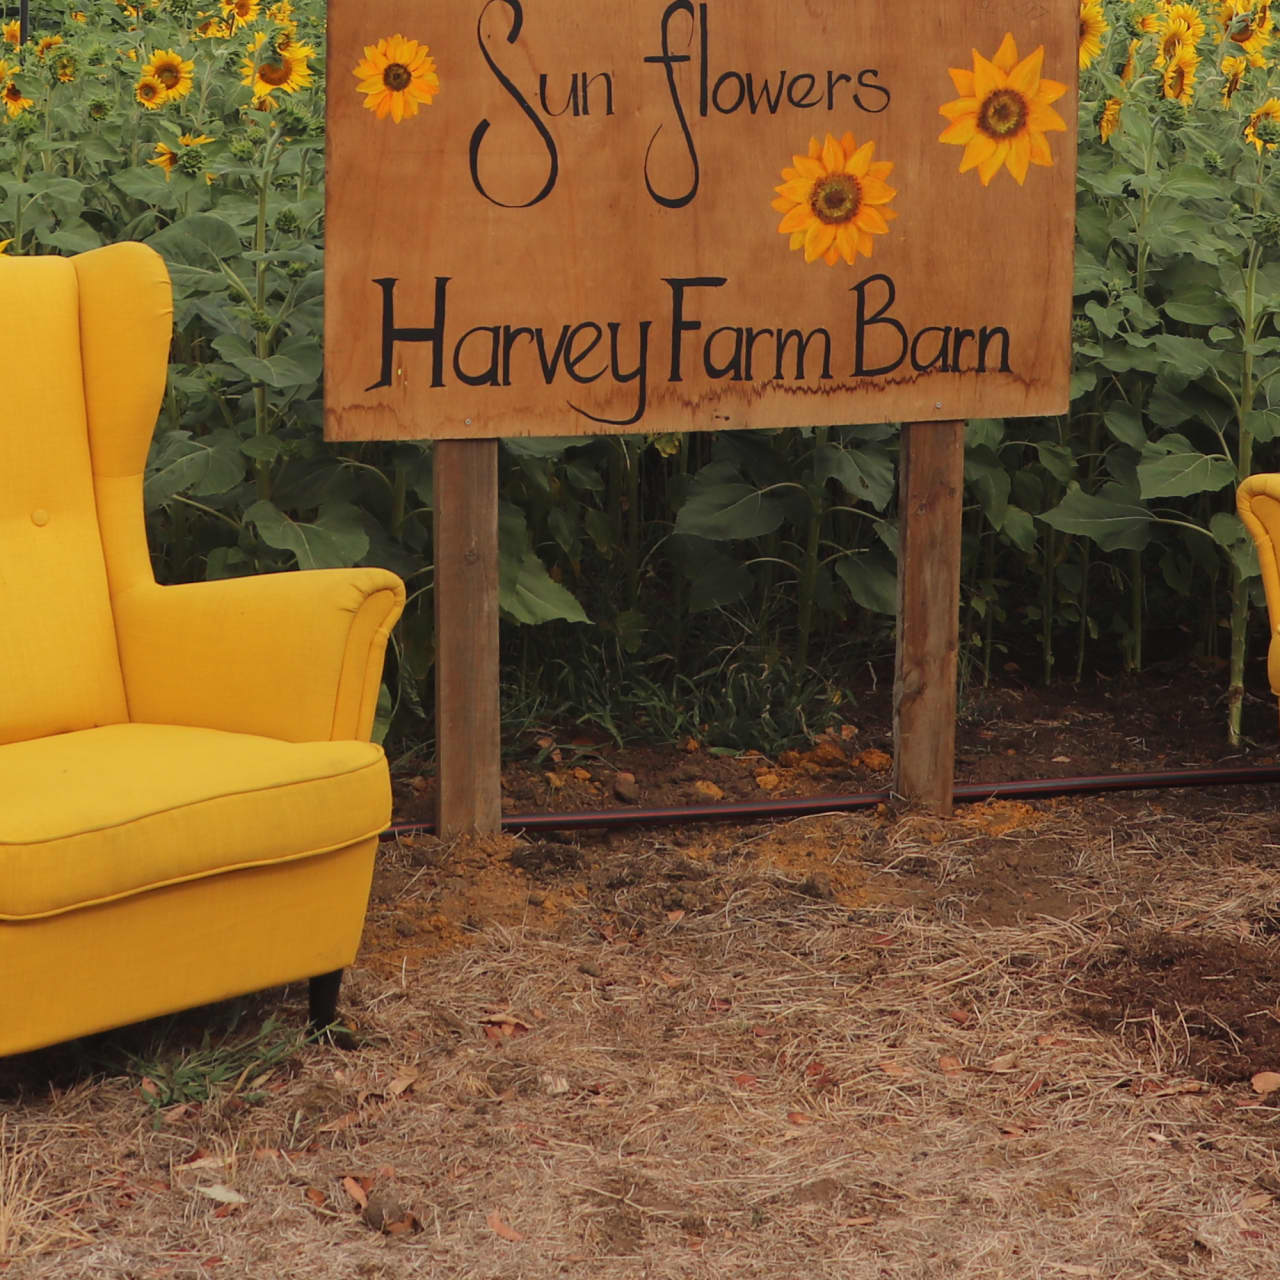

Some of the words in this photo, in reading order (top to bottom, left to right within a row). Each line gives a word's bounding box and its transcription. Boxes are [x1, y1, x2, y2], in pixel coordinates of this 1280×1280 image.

[365, 276, 651, 425] Harvey
[661, 277, 833, 382] Farm
[849, 273, 1013, 378] Barn
